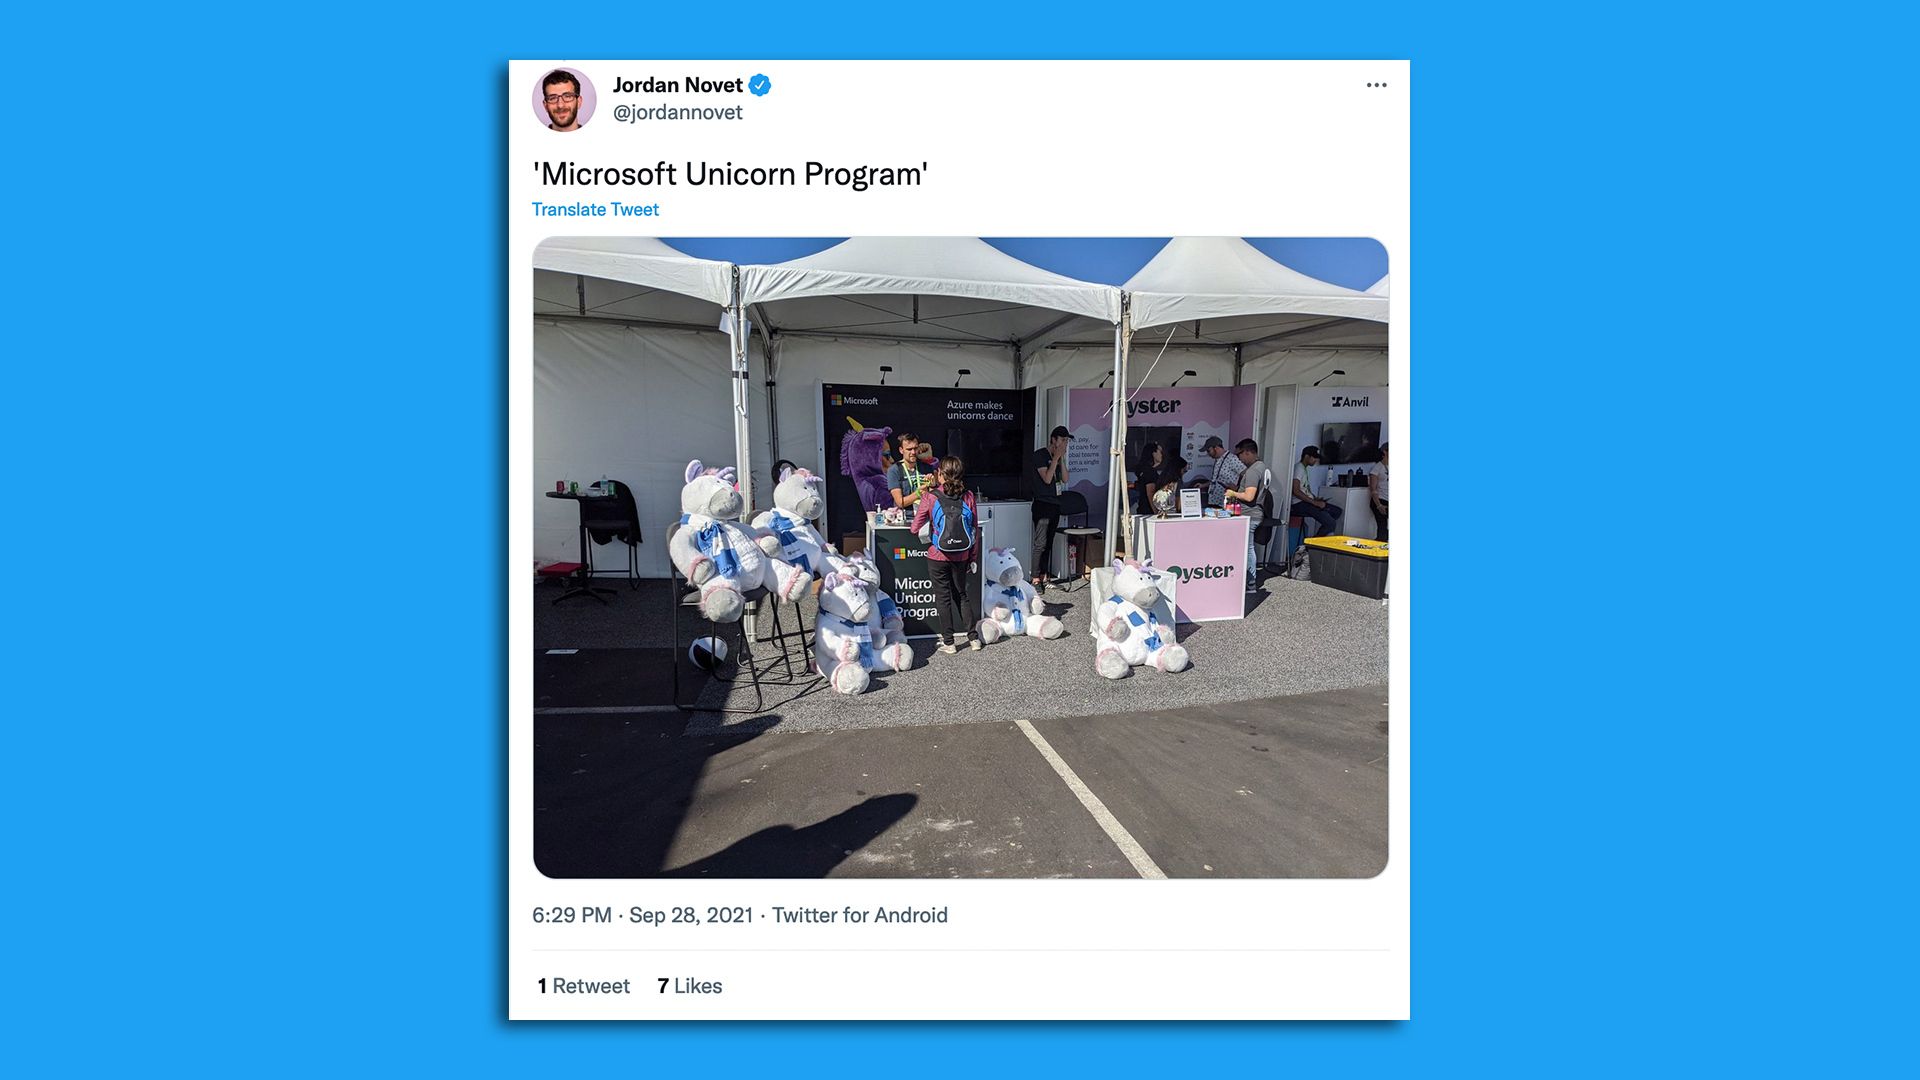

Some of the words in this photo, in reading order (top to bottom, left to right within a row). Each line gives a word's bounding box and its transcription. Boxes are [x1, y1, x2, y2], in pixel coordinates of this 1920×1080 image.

[843, 396, 879, 405] Microsoft
[946, 399, 973, 409] Azure
[975, 400, 1003, 410] makes
[1342, 396, 1369, 407] Anvil
[1109, 397, 1182, 418] yster
[947, 410, 986, 420] unicorns
[987, 410, 1014, 420] dance
[907, 549, 928, 558] Micro
[894, 577, 934, 590] Micro
[896, 606, 940, 621] Progra
